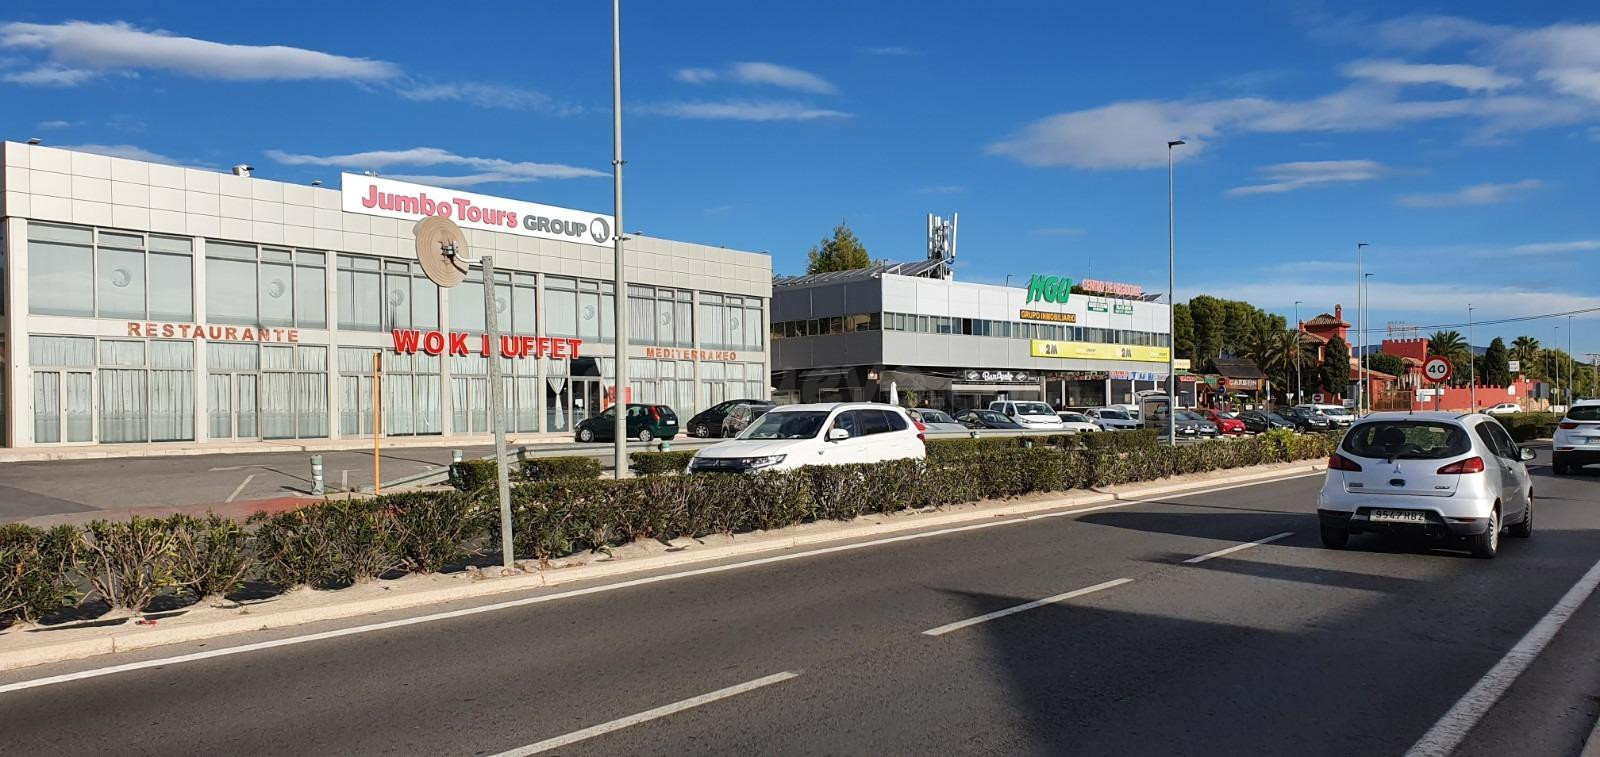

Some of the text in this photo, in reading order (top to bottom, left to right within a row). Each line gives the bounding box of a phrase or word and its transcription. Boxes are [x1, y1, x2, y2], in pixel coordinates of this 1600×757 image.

[362, 184, 587, 237] Jumbo Tours GROUP
[128, 322, 299, 343] RESTAURANTE
[392, 329, 469, 355] WOK
[1428, 364, 1446, 374] 40
